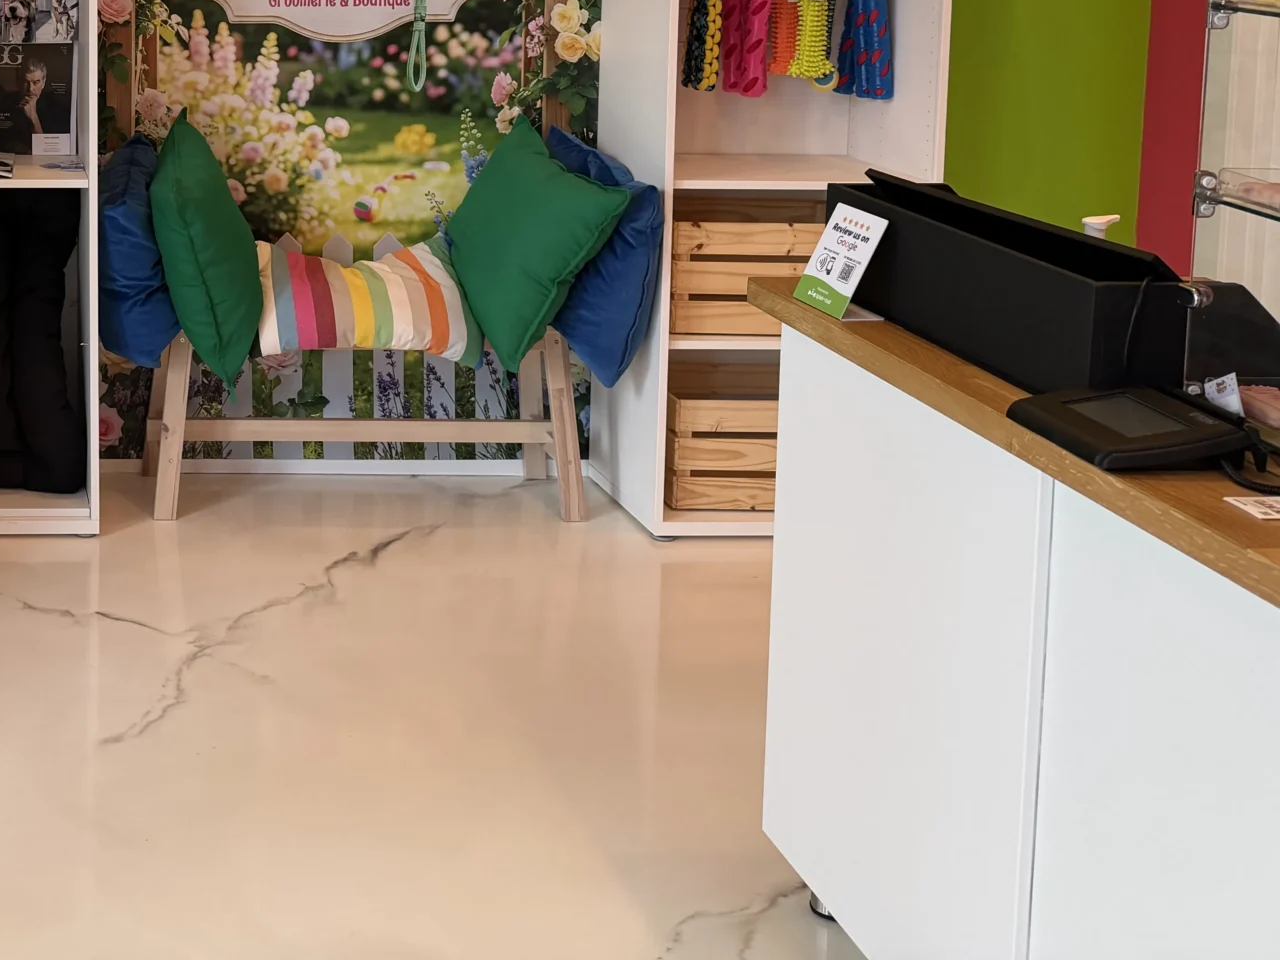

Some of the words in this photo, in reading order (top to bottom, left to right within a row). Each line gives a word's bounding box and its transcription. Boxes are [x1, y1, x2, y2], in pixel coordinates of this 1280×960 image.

[832, 222, 854, 237] Review
[852, 232, 861, 240] us
[861, 236, 870, 244] on
[836, 235, 858, 252] Google
